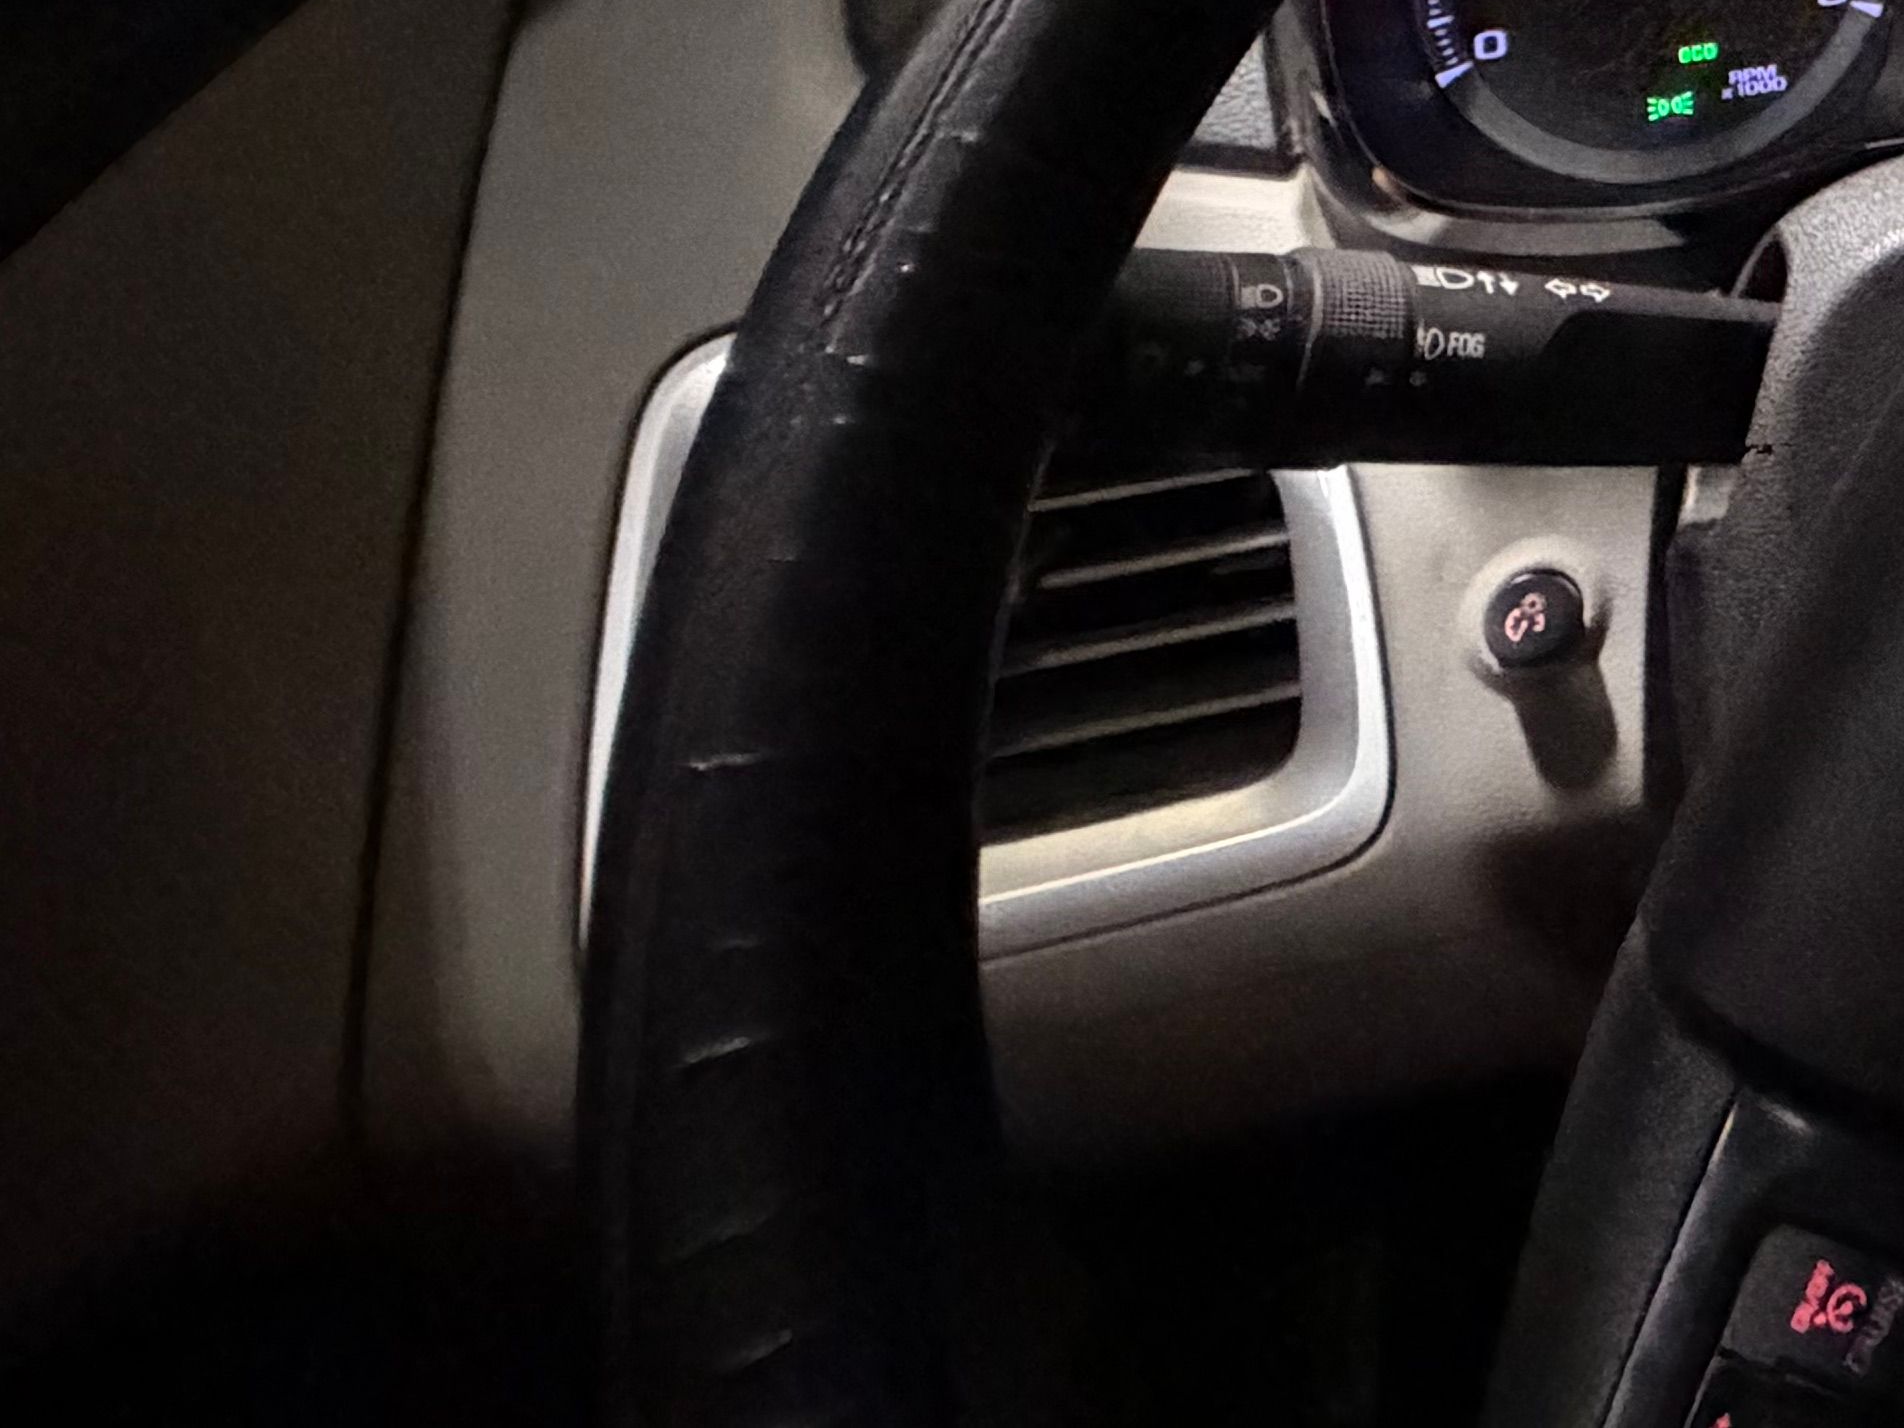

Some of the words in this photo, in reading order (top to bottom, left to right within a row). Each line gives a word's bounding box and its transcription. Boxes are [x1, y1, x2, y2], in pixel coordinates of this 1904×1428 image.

[1473, 28, 1510, 61] 0
[1729, 64, 1777, 85] RPM
[1447, 330, 1486, 359] FOG
